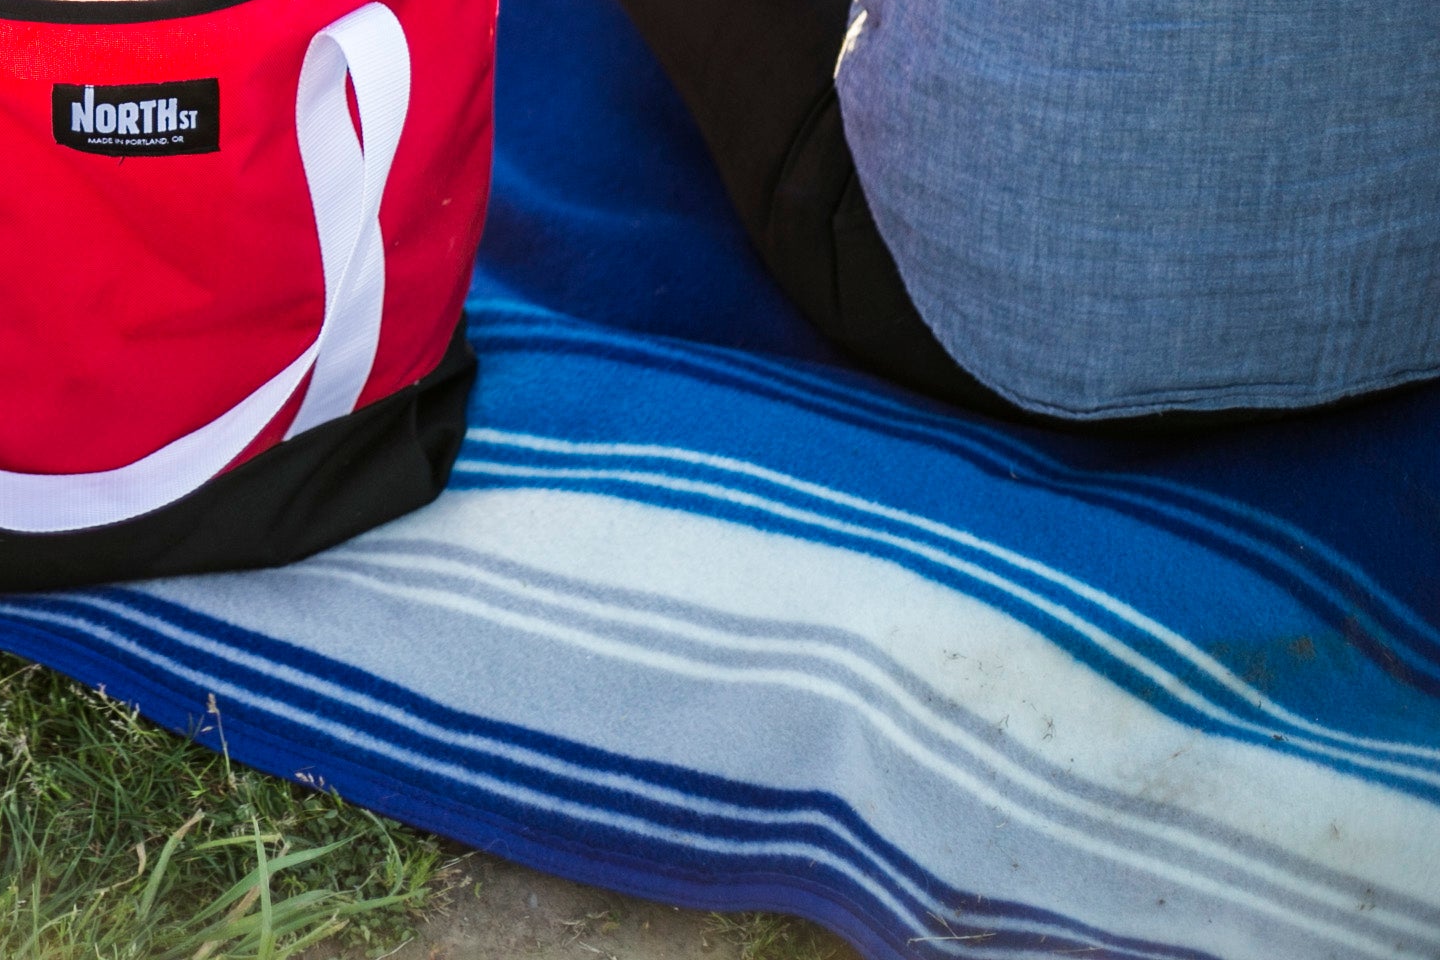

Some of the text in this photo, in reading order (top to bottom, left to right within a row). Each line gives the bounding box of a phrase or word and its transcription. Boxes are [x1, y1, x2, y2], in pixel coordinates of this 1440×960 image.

[71, 84, 198, 135] NORTH ST
[171, 135, 184, 143] OR
